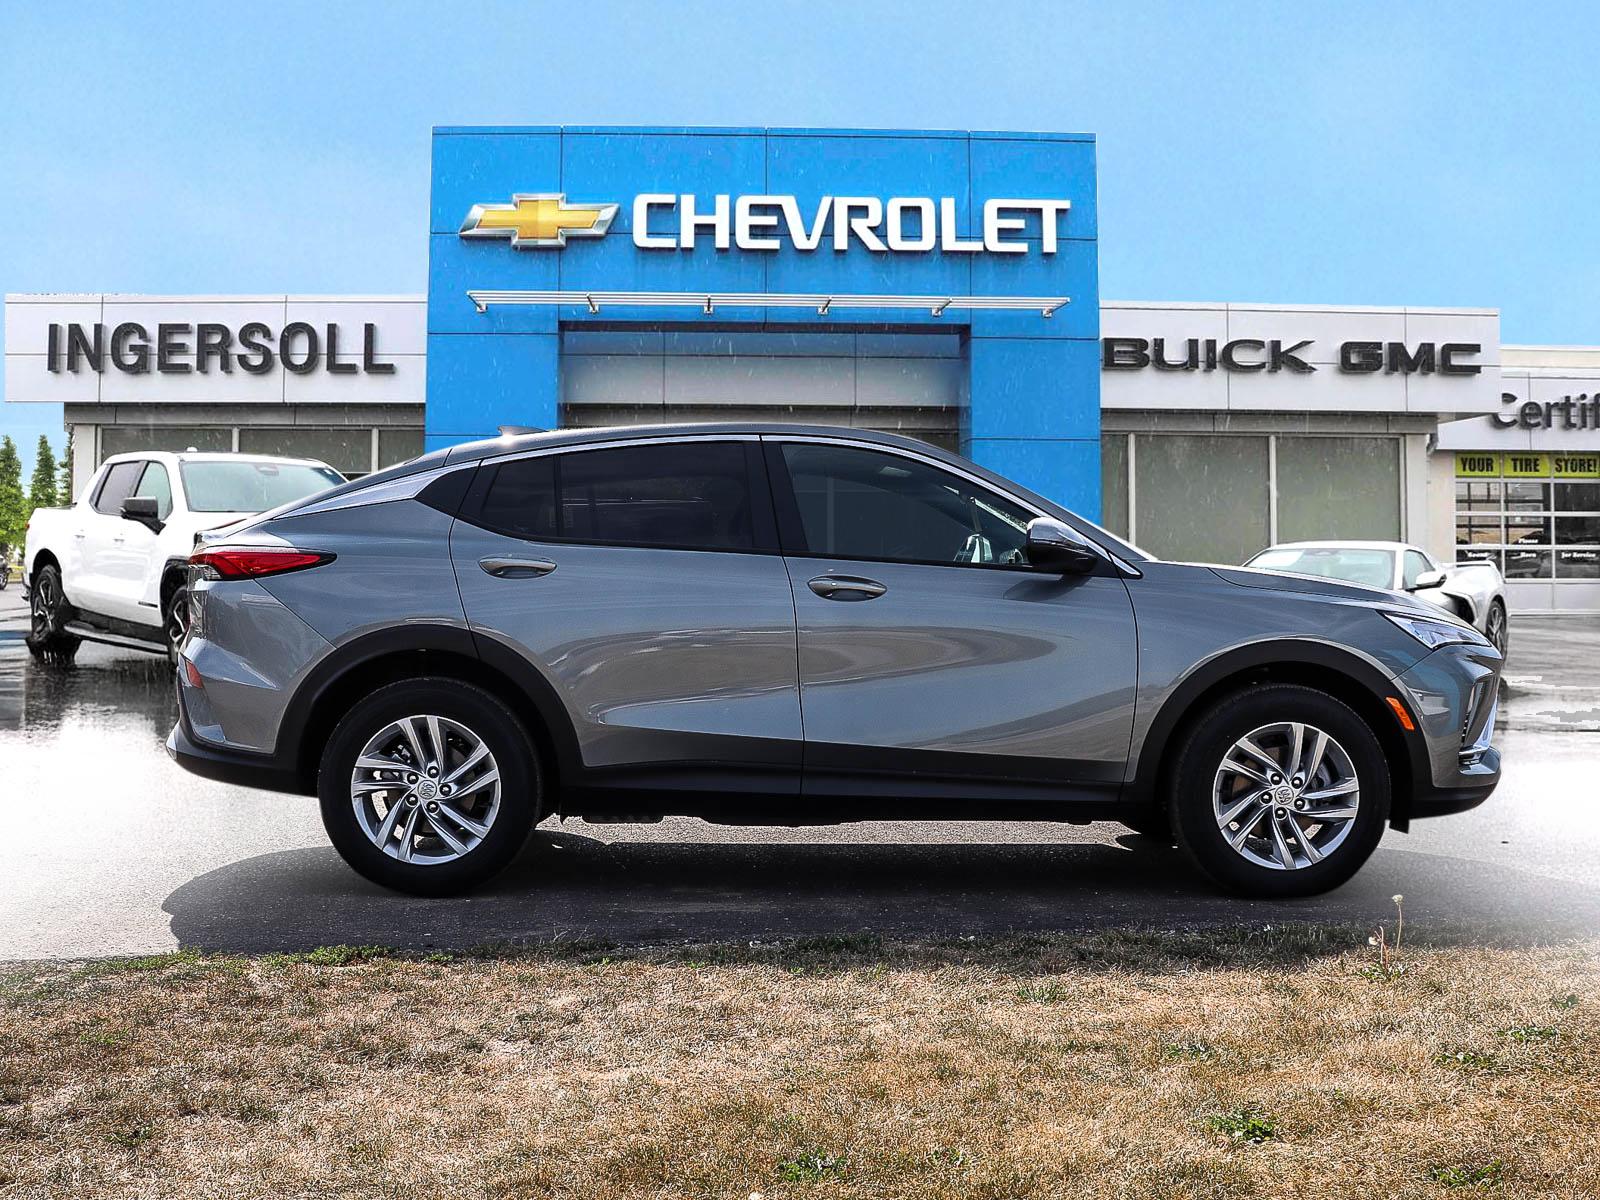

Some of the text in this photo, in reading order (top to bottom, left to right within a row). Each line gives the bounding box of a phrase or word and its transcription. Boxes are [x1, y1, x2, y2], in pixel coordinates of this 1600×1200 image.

[632, 193, 1071, 253] CHEVROLET
[47, 322, 396, 374] INGERSOLL
[1102, 337, 1482, 374] BUICK GMC
[1461, 457, 1597, 473] YOUR TIRE STORE!
